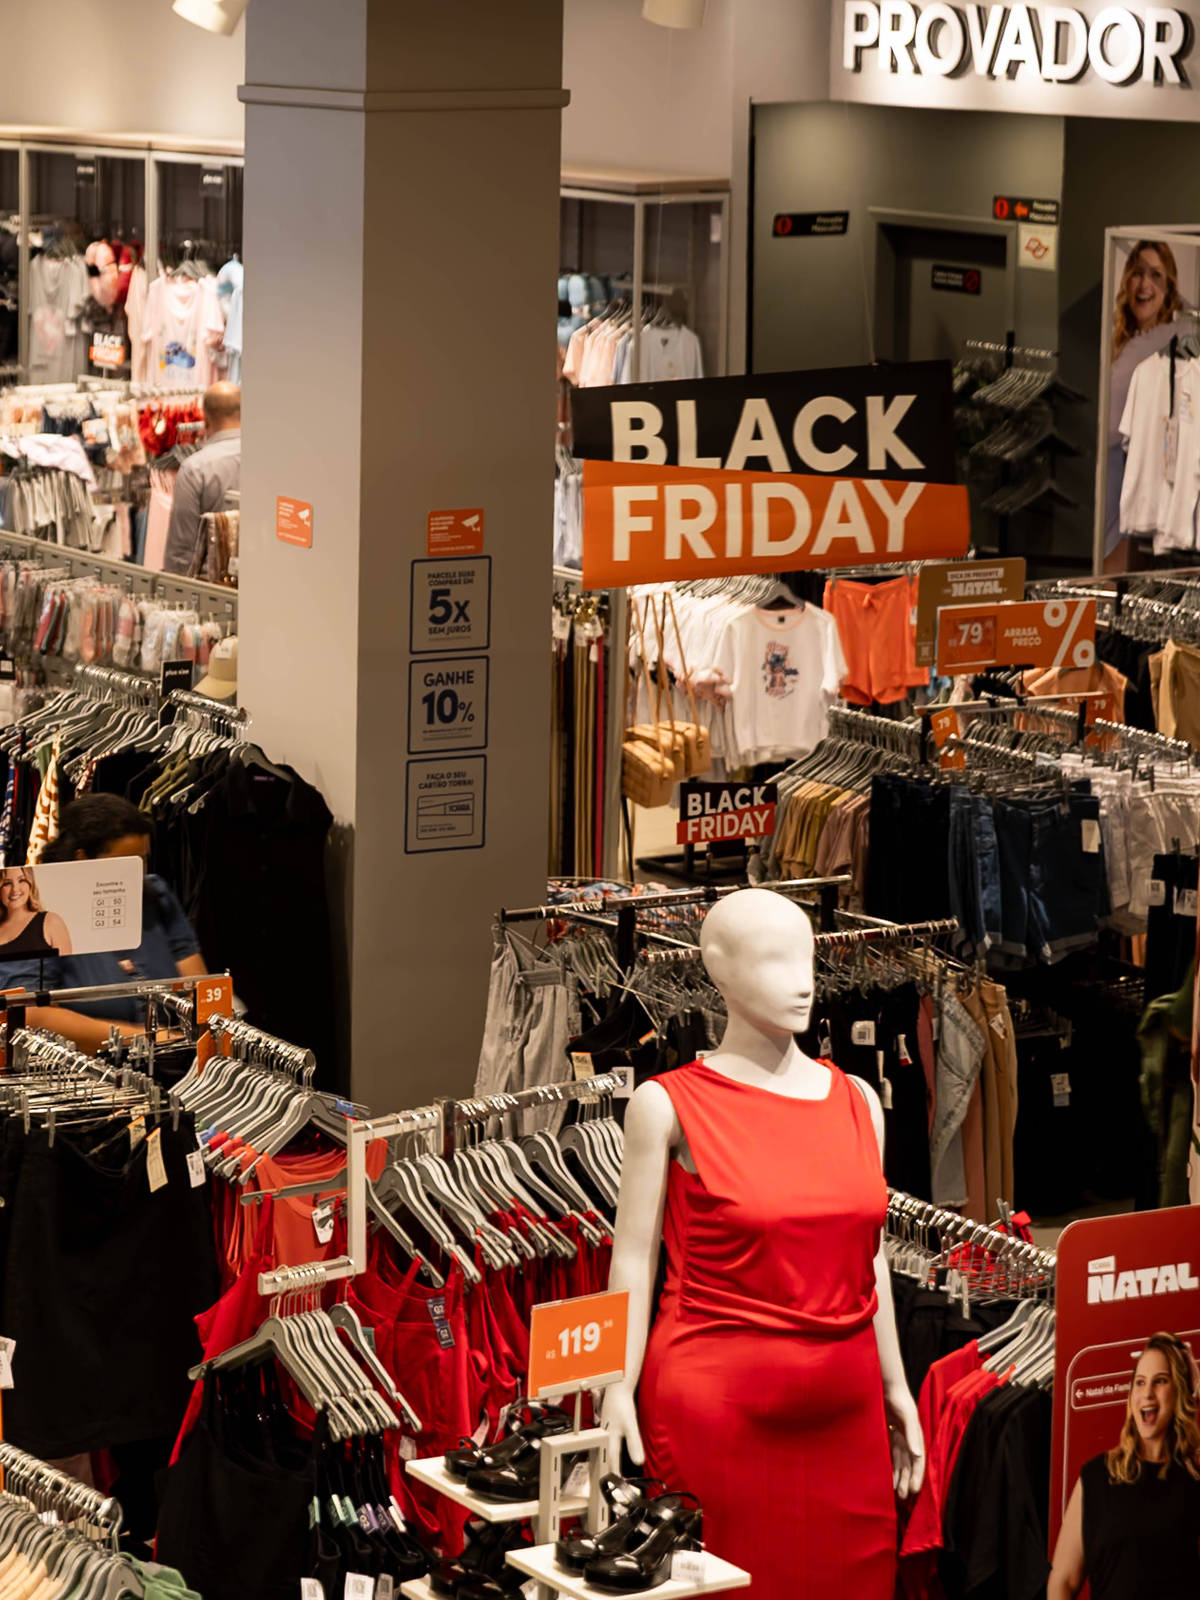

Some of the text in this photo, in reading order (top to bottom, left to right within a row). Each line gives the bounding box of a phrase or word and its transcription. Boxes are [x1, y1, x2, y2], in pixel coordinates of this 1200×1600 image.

[843, 0, 1186, 86] PROVADOR
[610, 395, 926, 473] BLACK
[612, 480, 927, 562] FRIDAY
[952, 580, 1003, 597] NATAL
[428, 625, 471, 635] SEM JUROS
[957, 622, 983, 646] 79
[1004, 627, 1039, 638] ARRASA
[1012, 637, 1042, 648] PREÇO
[423, 670, 475, 687] GANHE
[422, 688, 476, 725] 10%
[687, 786, 767, 816] BLACK
[687, 809, 770, 841] FRIDAY
[206, 988, 222, 1002] 39
[1087, 1262, 1199, 1304] NATAL
[558, 1322, 600, 1357] 119
[1086, 1386, 1104, 1397] Natal
